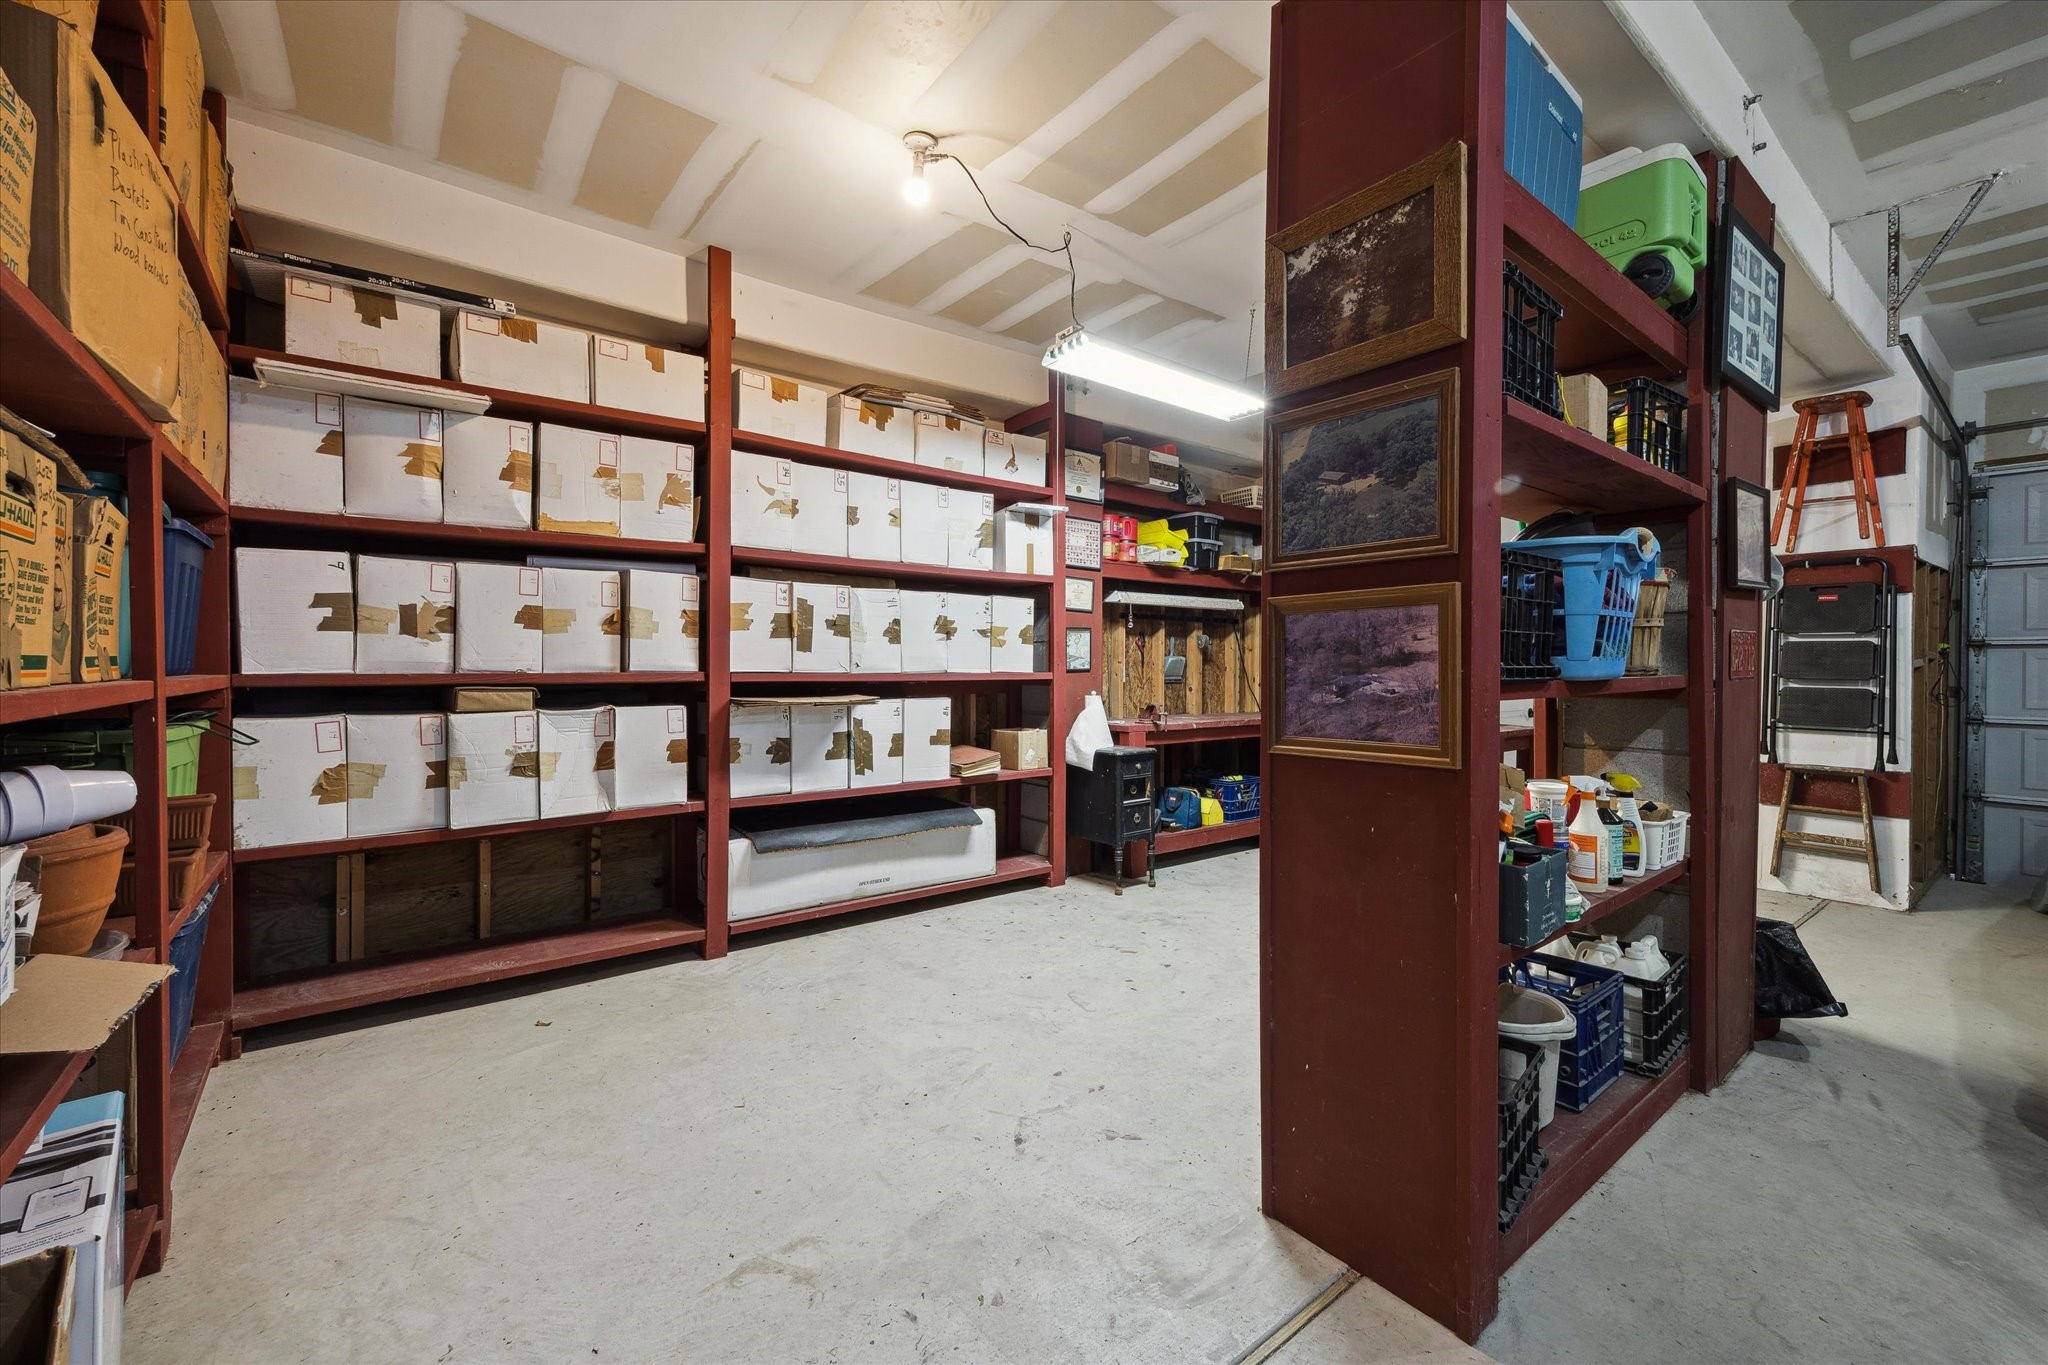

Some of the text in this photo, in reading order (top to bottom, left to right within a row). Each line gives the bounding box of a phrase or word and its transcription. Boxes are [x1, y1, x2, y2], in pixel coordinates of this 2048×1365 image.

[110, 165, 150, 210] Baskets
[230, 247, 259, 258] Filtrete
[284, 253, 312, 264] Filtrete
[837, 473, 845, 487] 35
